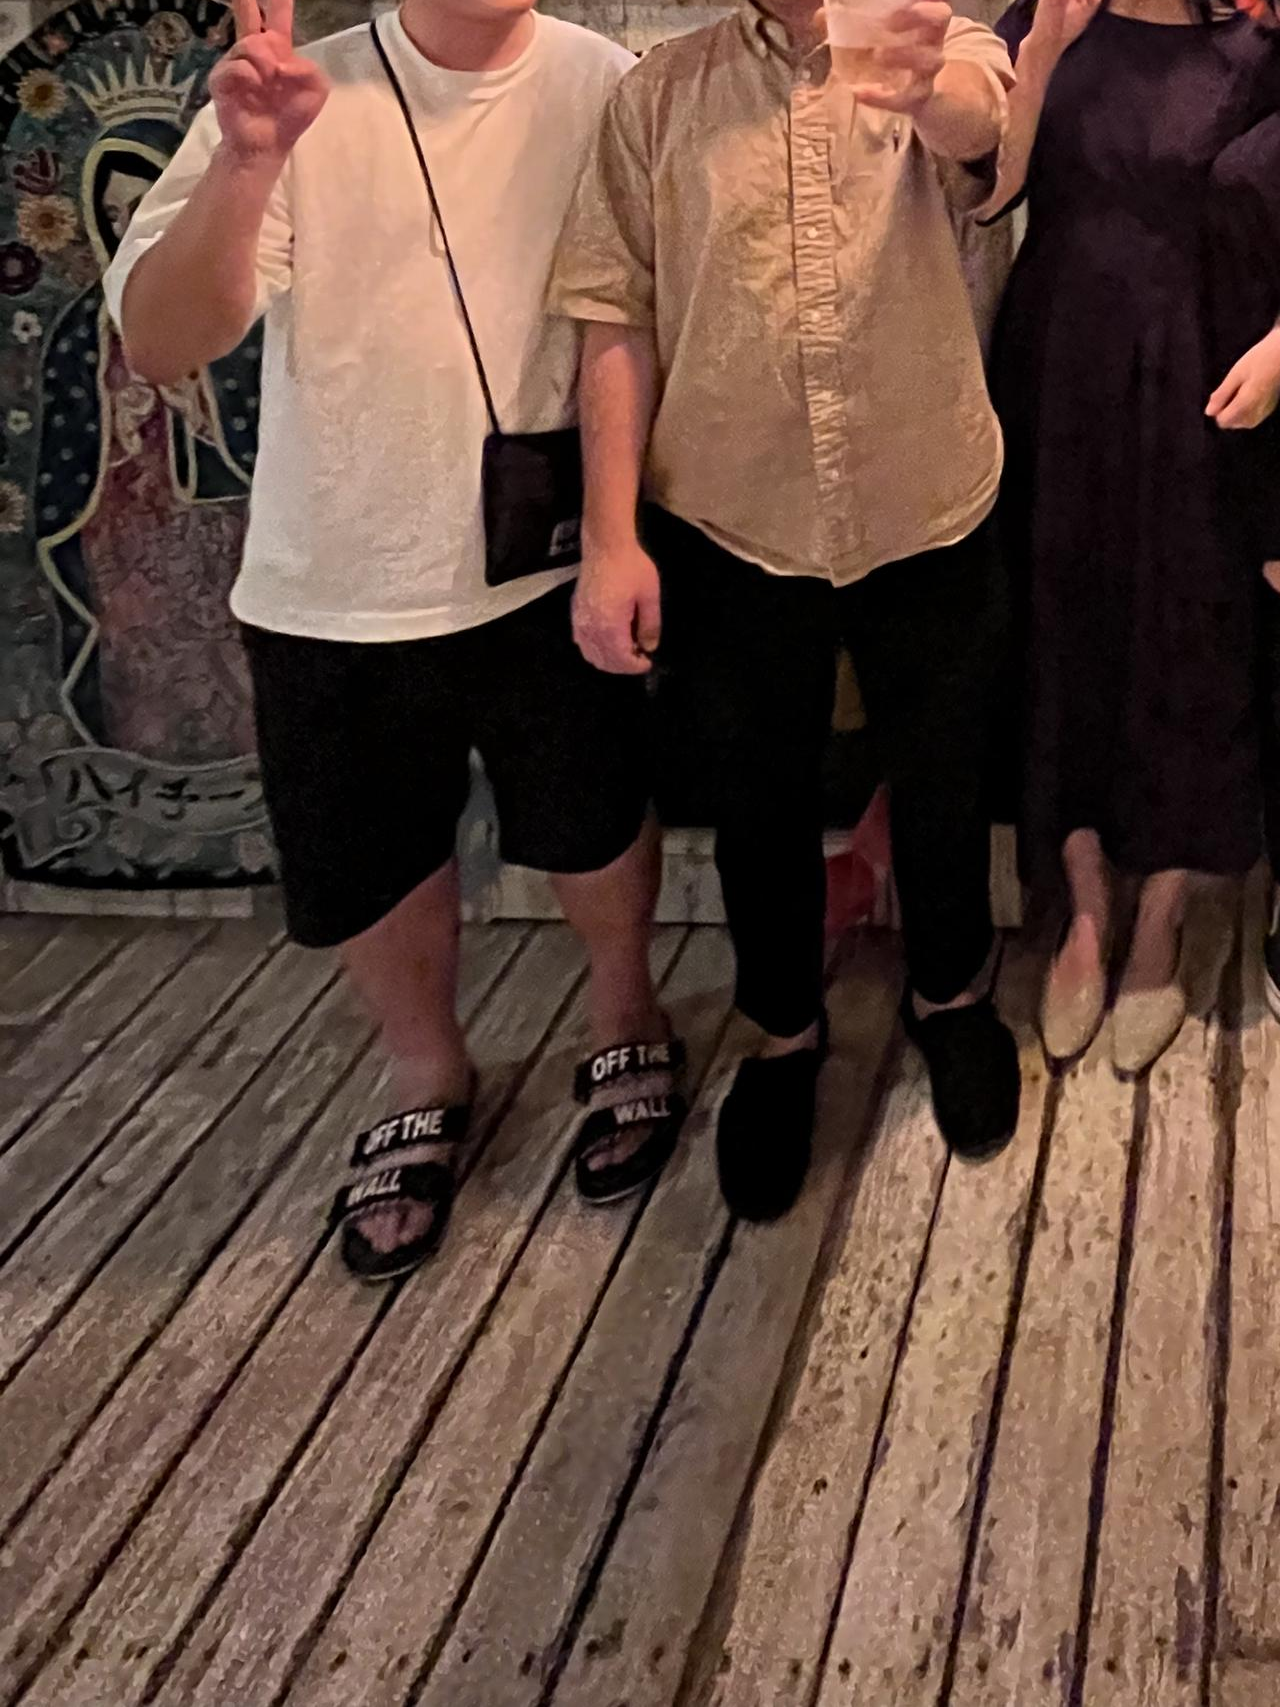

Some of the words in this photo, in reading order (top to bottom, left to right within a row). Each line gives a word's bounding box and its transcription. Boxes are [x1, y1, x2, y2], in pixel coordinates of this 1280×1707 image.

[592, 1047, 630, 1080] OFF
[636, 1045, 669, 1064] THE
[614, 1098, 670, 1124] WALL
[364, 1120, 399, 1153] OFF
[402, 1111, 443, 1139] THE
[349, 1170, 400, 1204] WALL
